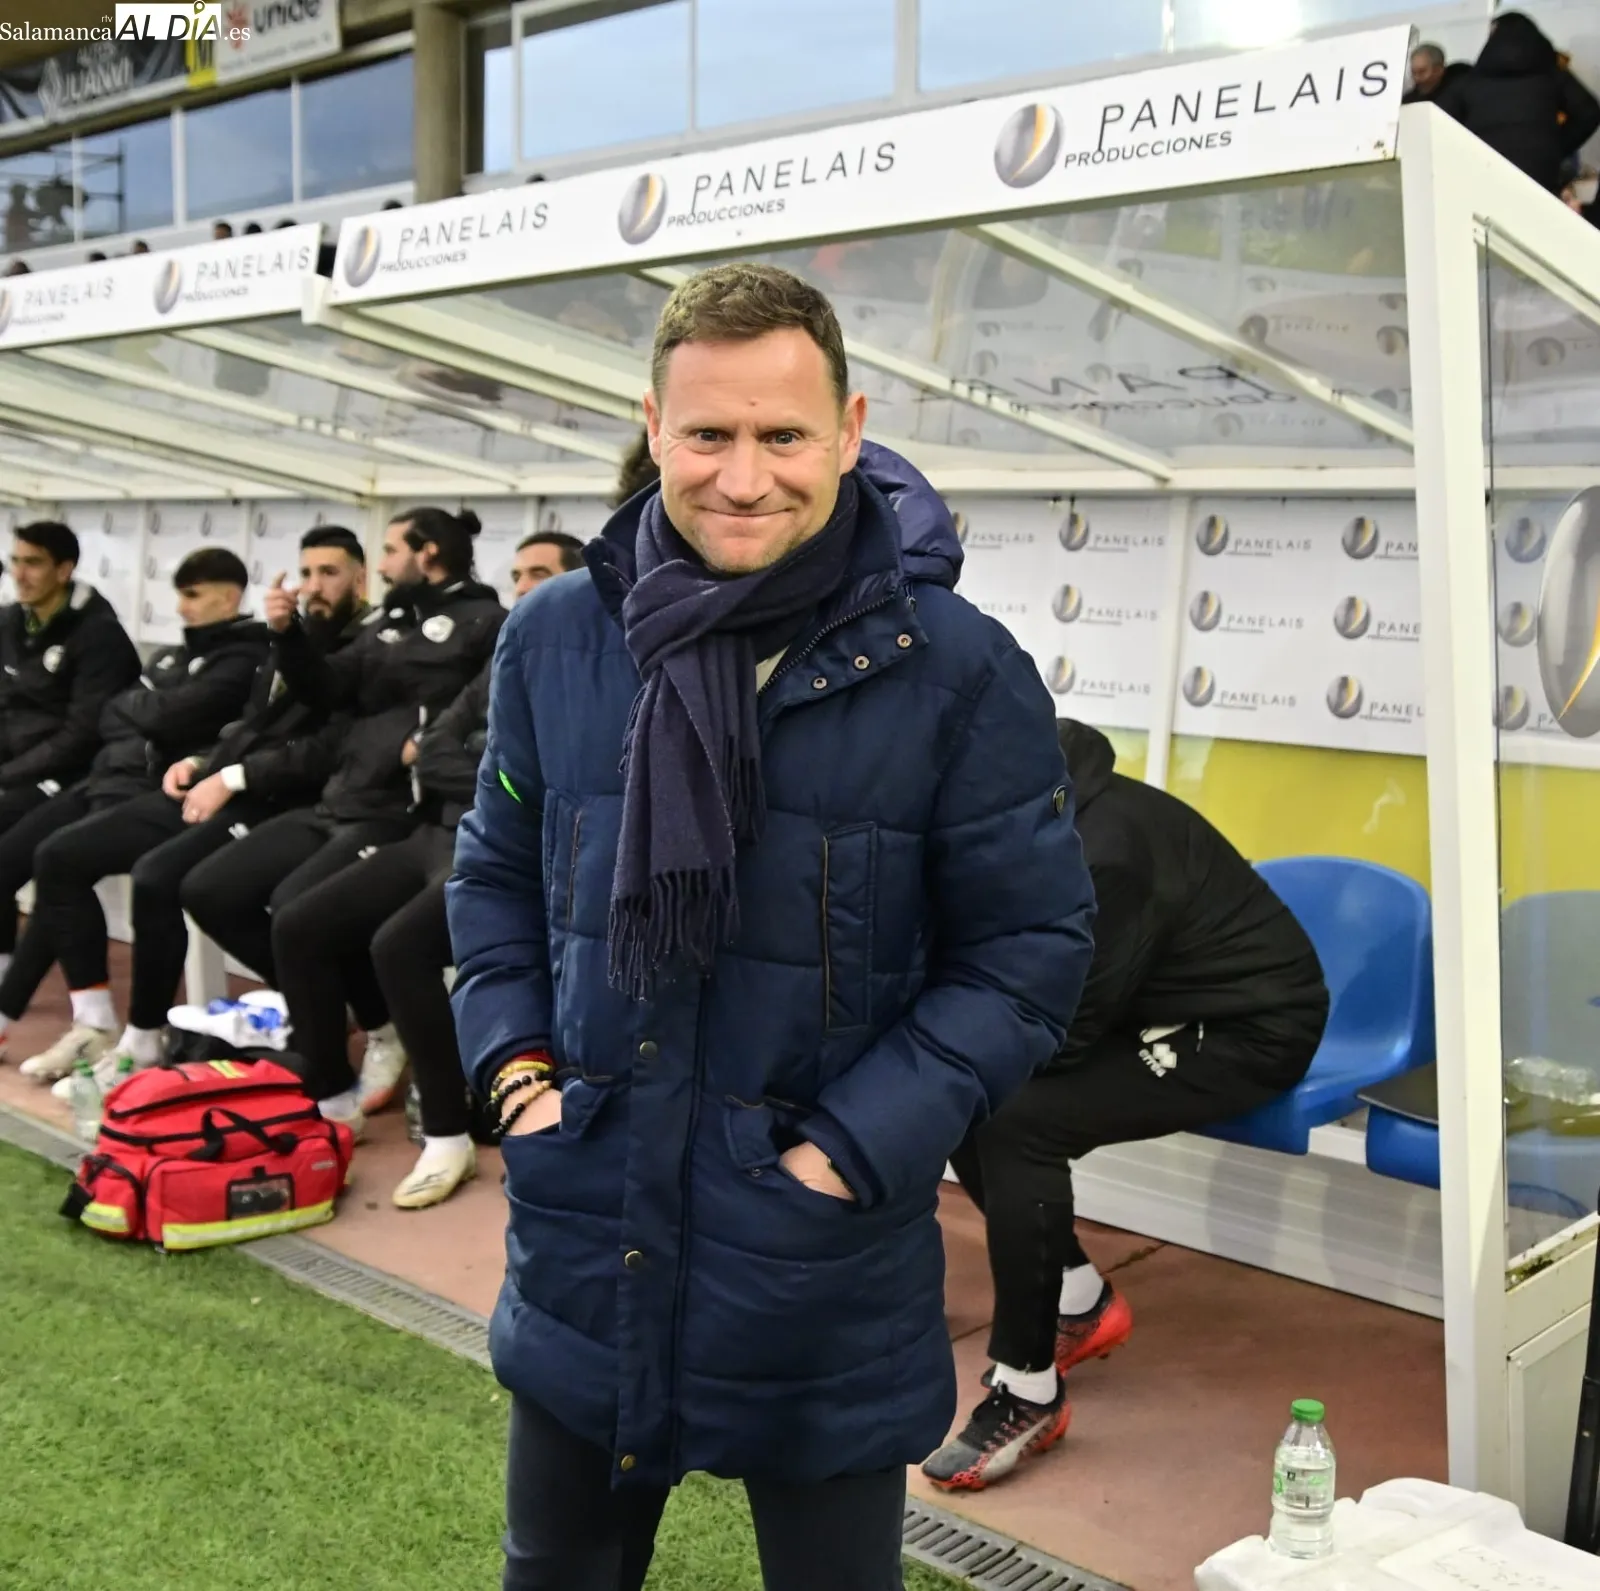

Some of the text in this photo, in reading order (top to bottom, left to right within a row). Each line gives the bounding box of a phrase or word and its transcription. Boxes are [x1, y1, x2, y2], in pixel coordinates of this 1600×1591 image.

[1098, 60, 1389, 152] PANELAIS
[1064, 130, 1232, 168] PRODUCCIONES
[691, 141, 896, 214] PANELAIS
[667, 199, 785, 228] PRODUCCIONES
[398, 202, 549, 262] PANELAIS
[195, 246, 310, 290] PANELAIS
[380, 251, 467, 272] PRODUCCIONES
[972, 532, 1034, 545] PANELAIS
[1094, 534, 1165, 547] PANELAIS
[1234, 538, 1312, 552] PANELAIS
[1088, 608, 1158, 621] PANELAIS
[1227, 614, 1304, 629] PANELAIS
[1081, 680, 1150, 694] PANELAIS
[1220, 691, 1296, 707] PANELAIS
[1371, 702, 1425, 717] PANEL
